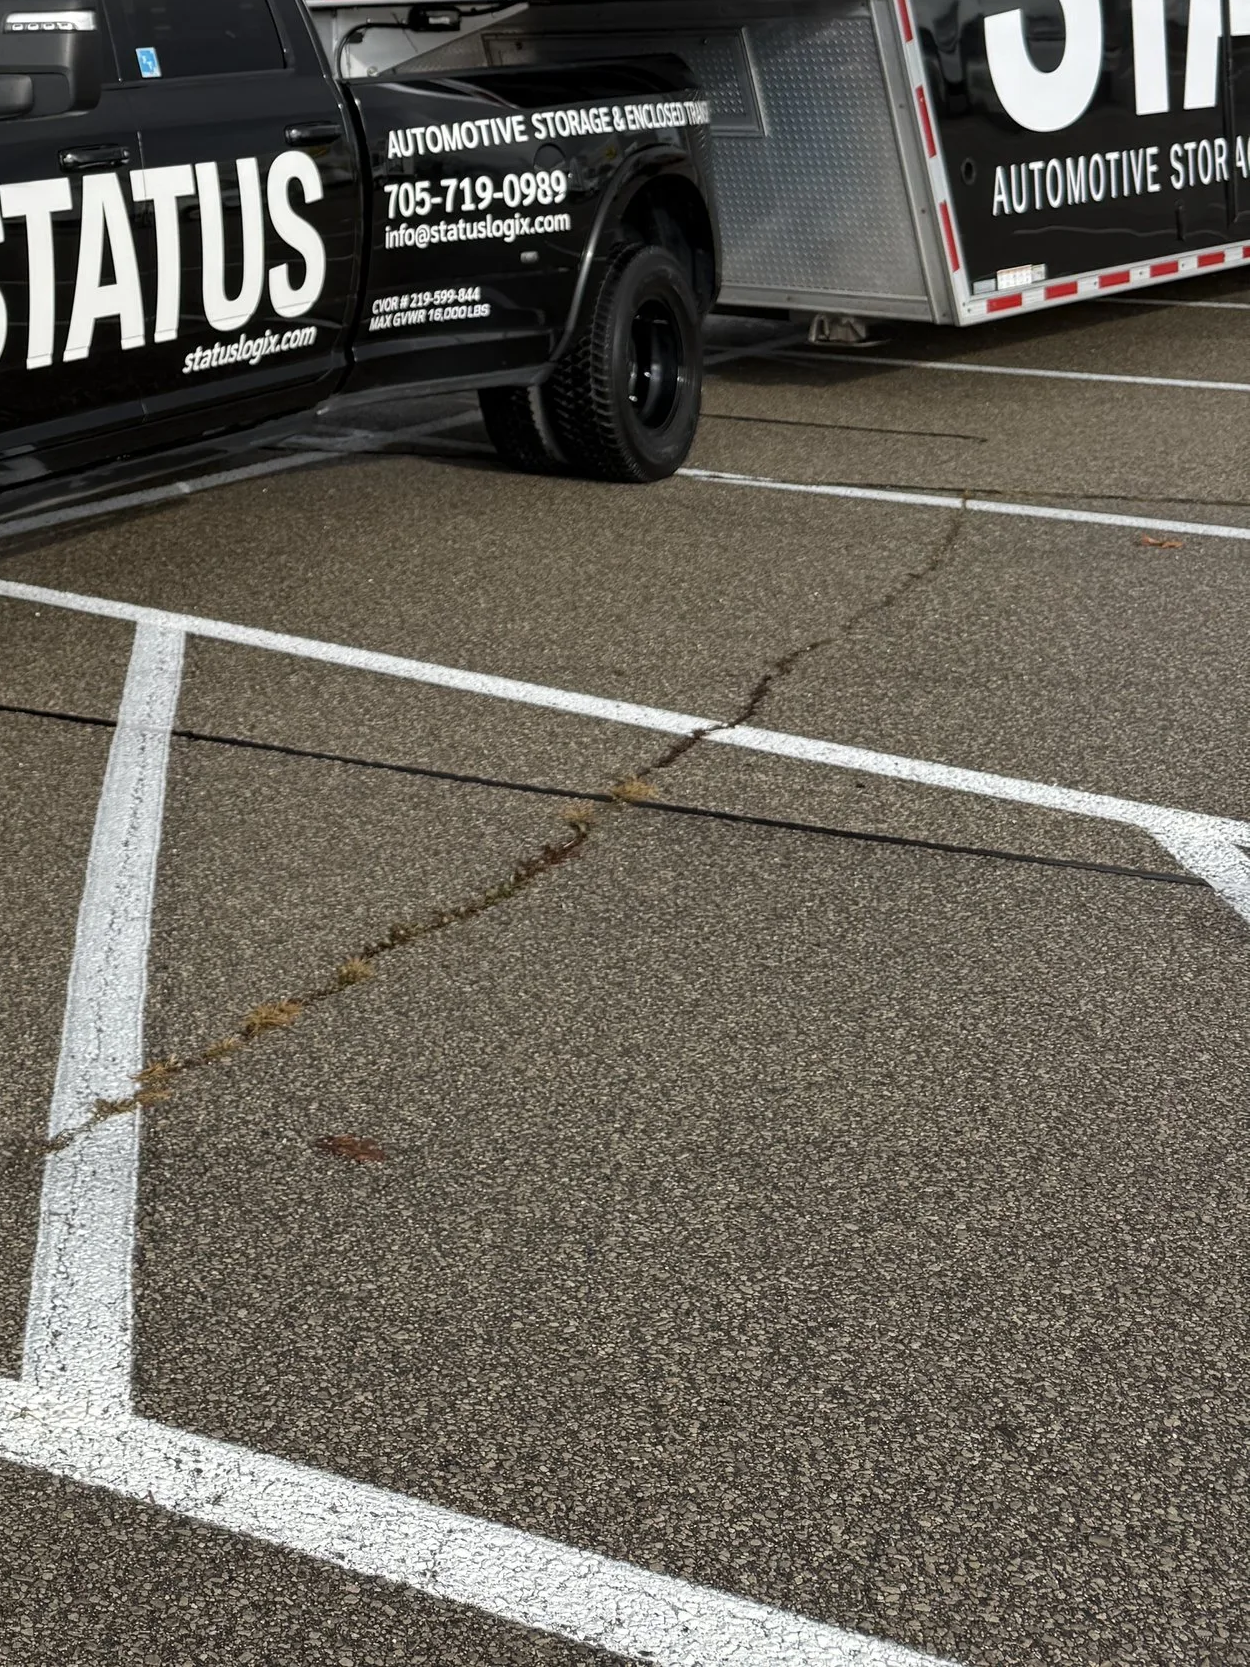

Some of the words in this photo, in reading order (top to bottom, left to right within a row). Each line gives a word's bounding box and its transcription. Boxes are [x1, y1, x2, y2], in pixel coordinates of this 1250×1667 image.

[387, 115, 528, 159] AUTOMOTIVE
[531, 107, 614, 140] STORAGE
[612, 105, 626, 131] &
[624, 102, 686, 131] ENCLOSED
[384, 169, 567, 219] 705-719-0989
[992, 146, 1162, 216] AUTOMOTIVE
[1169, 135, 1250, 190] STORA
[384, 212, 572, 249] info@statuslogix.com
[369, 313, 393, 331] MAX
[392, 309, 427, 327] GVWR
[372, 295, 400, 314] CVOR
[399, 294, 409, 310] #
[410, 286, 481, 308] 219-599-844
[182, 325, 318, 374] statuslogix.com
